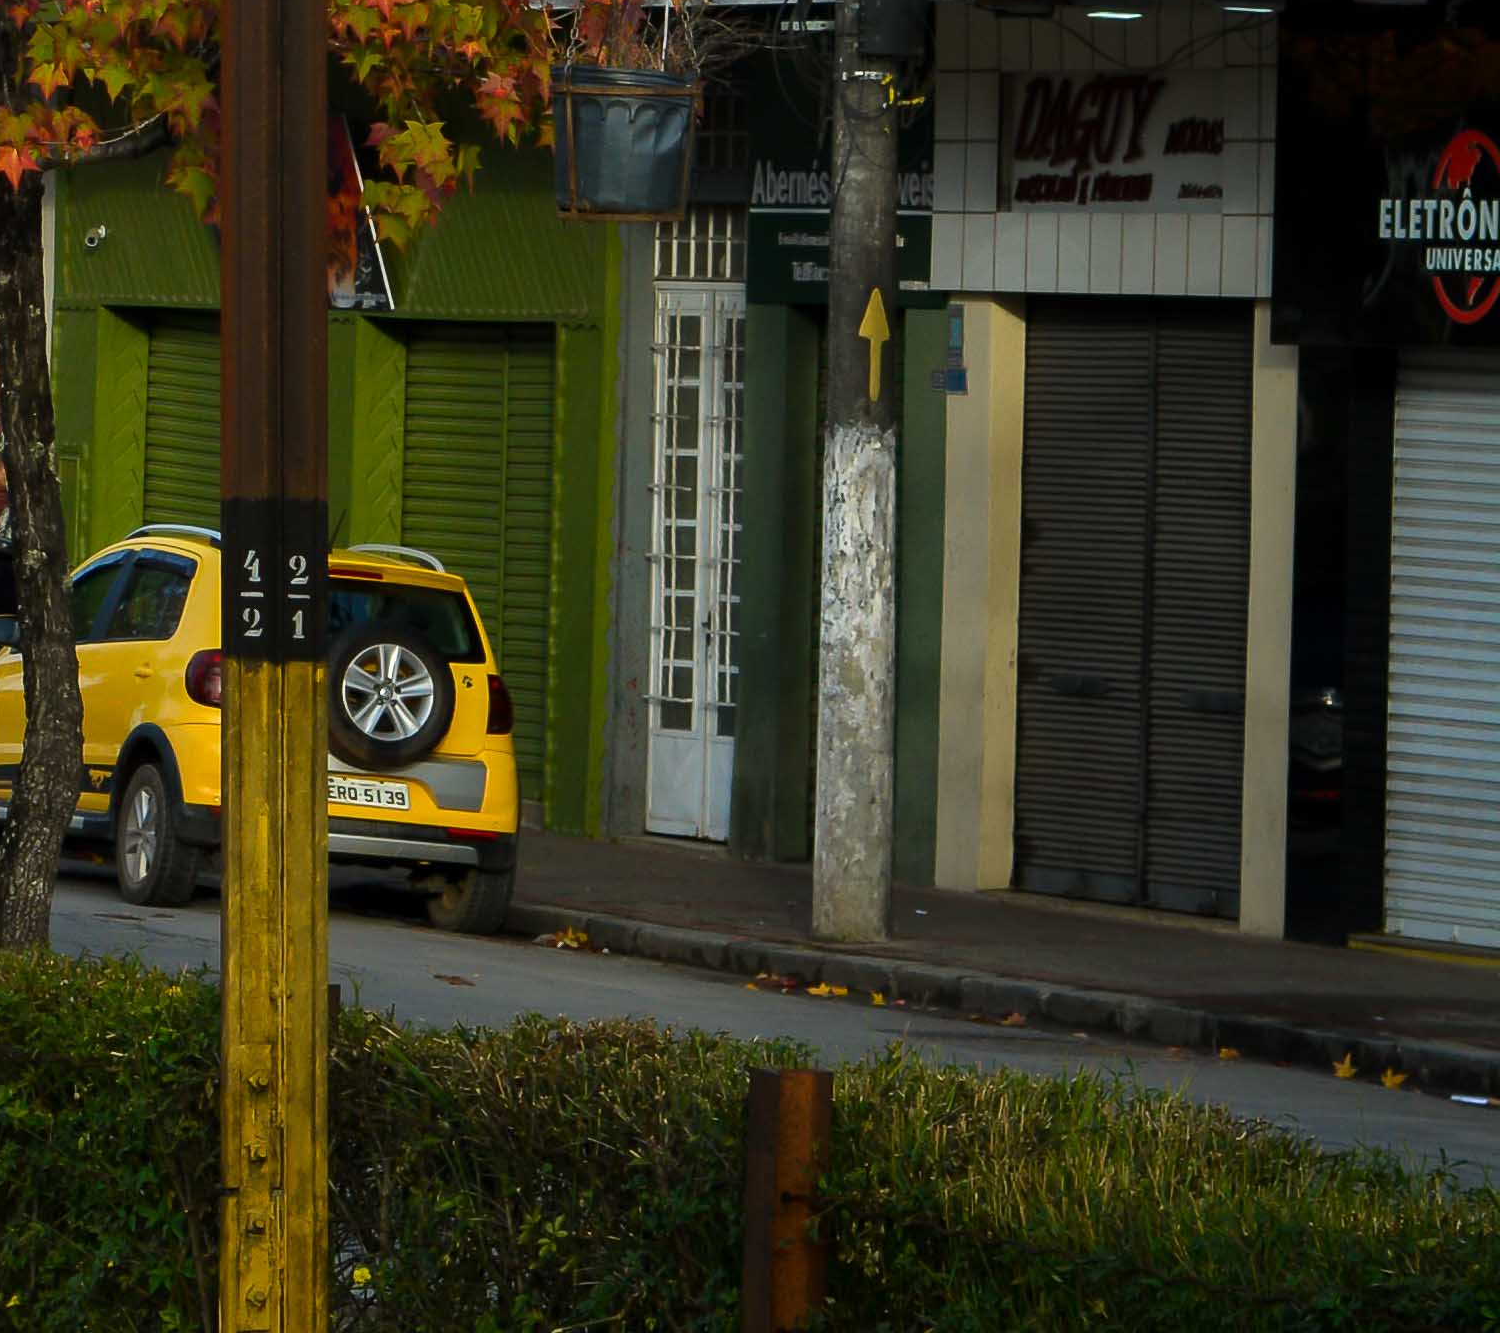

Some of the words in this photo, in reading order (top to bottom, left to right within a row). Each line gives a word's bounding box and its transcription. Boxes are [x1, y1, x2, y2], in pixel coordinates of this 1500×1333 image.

[751, 159, 831, 205] Abernés
[898, 166, 933, 207] veis
[1378, 186, 1500, 241] ELETRÔN
[1425, 247, 1500, 272] UNIVERSA
